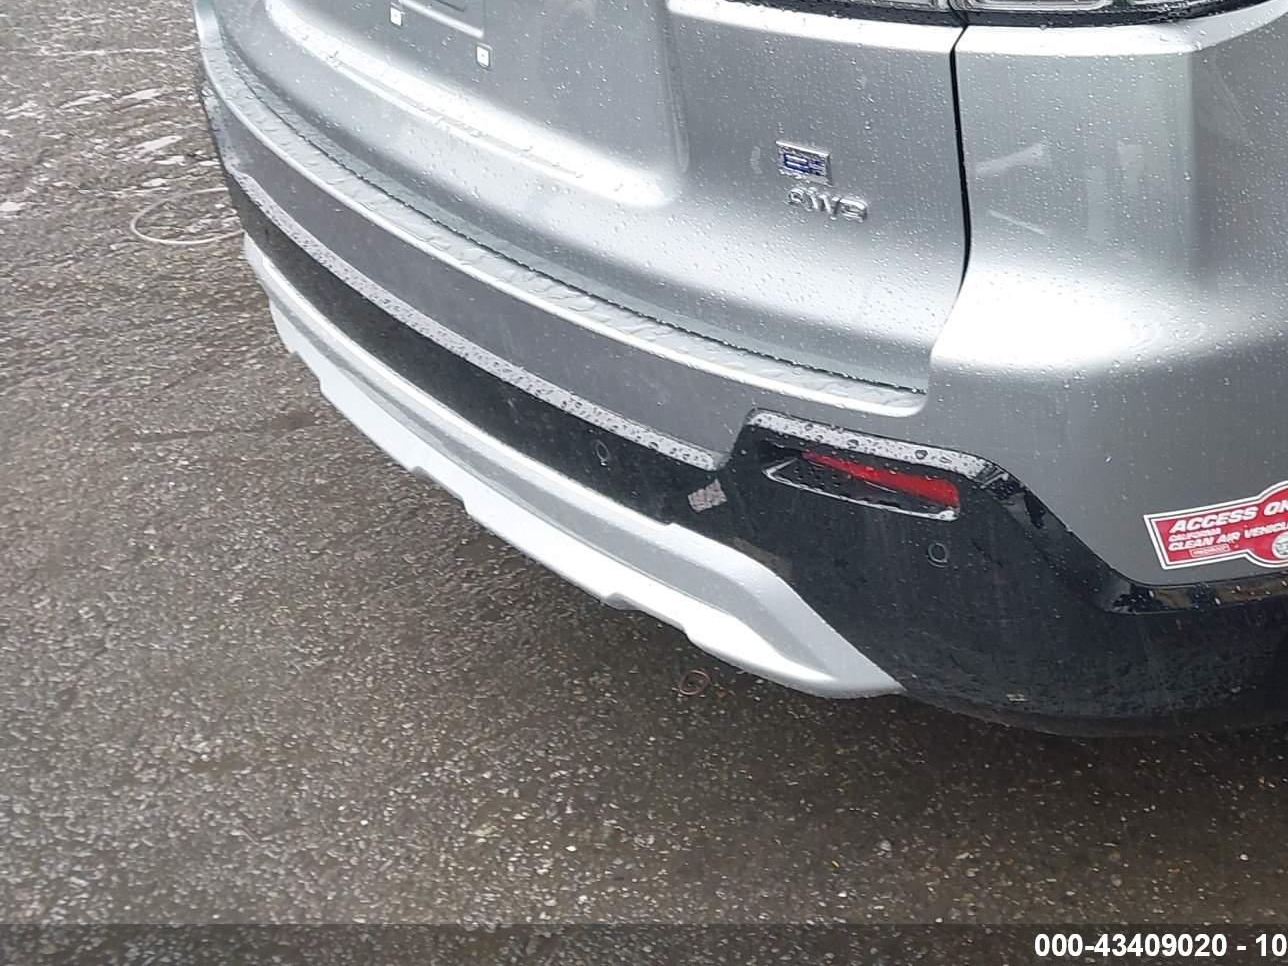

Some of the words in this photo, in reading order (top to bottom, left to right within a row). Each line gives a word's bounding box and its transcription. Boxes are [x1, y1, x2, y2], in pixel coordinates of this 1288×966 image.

[1169, 506, 1259, 534] ACCESS
[1168, 536, 1215, 552] CLEAN
[1216, 531, 1241, 545] AIR
